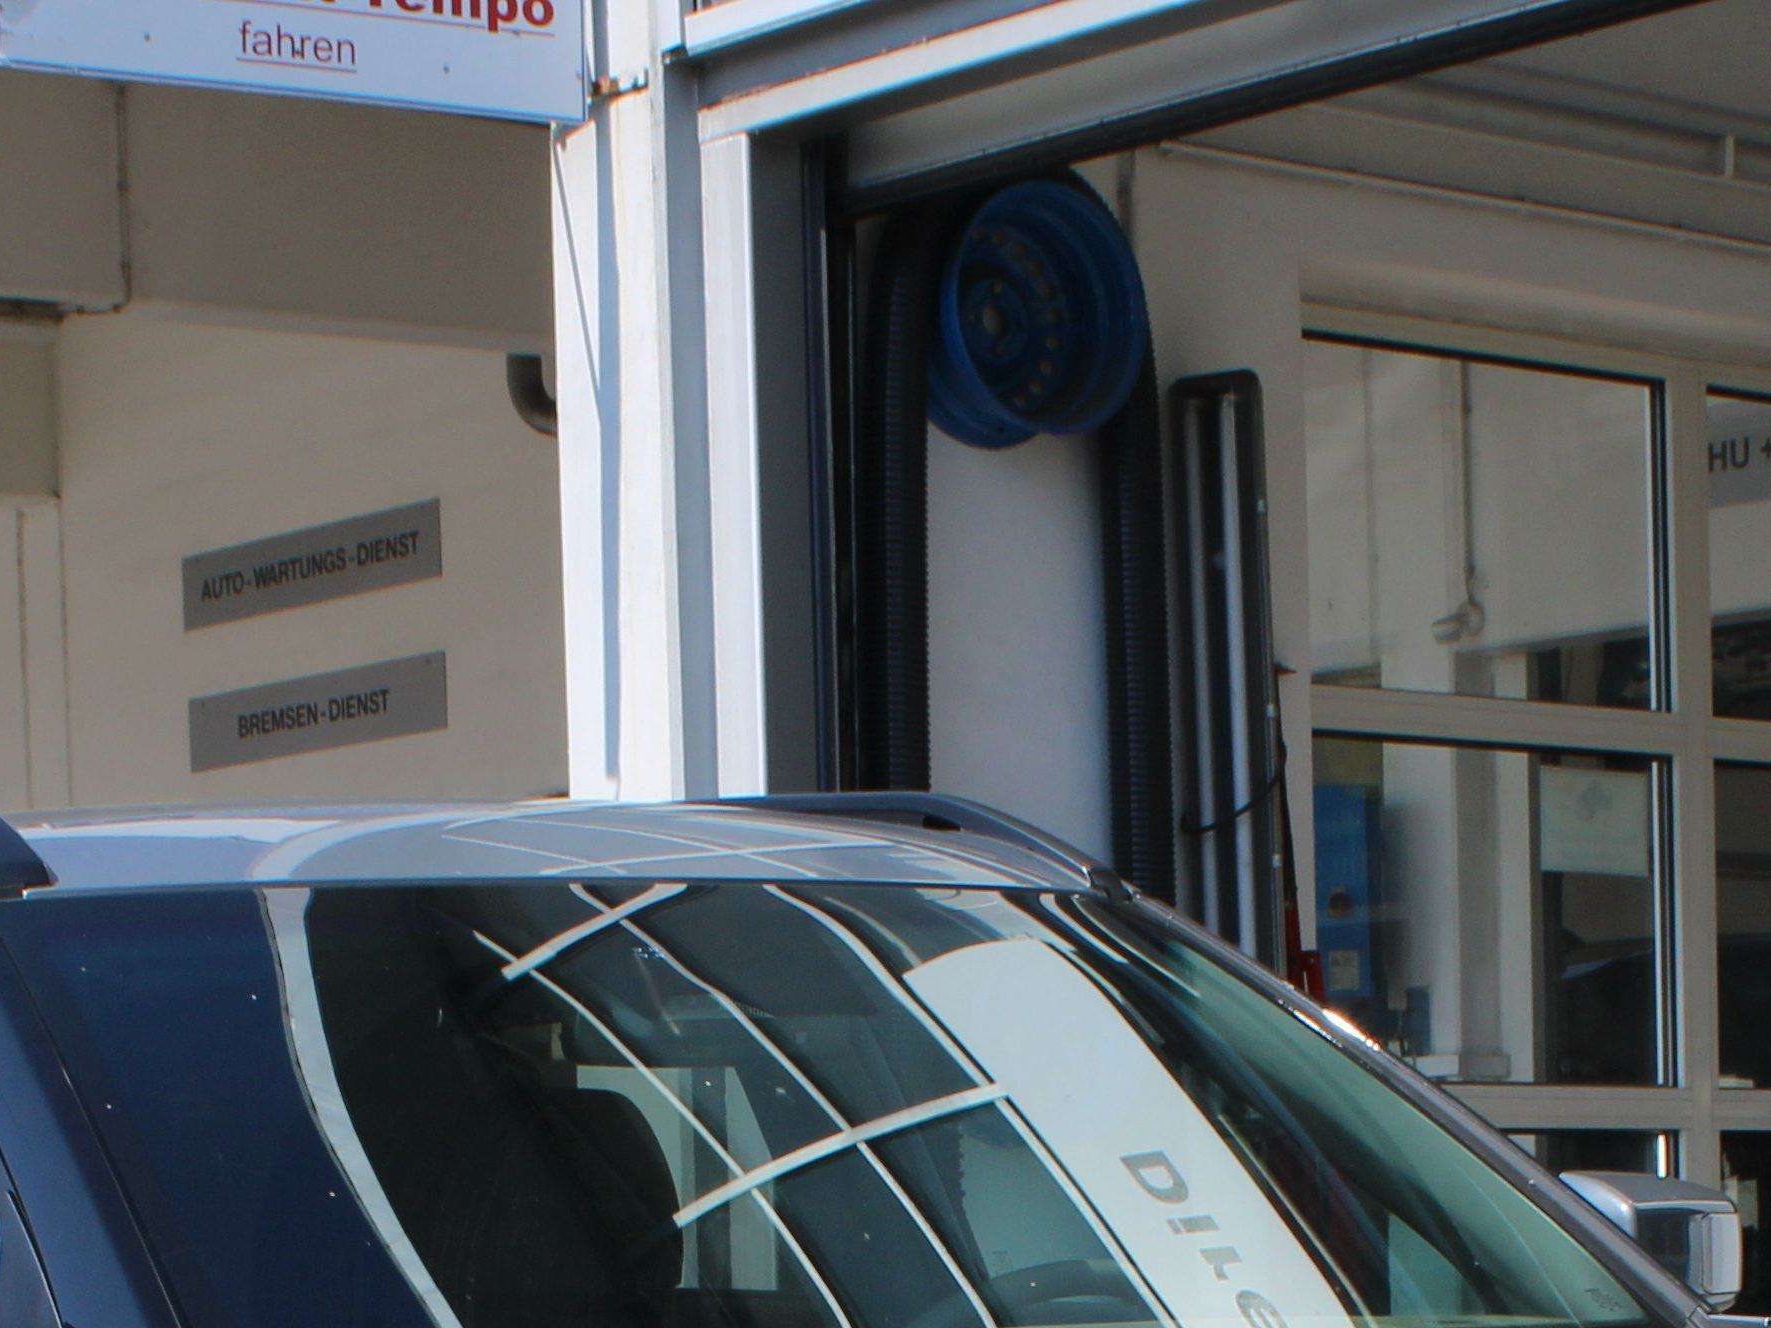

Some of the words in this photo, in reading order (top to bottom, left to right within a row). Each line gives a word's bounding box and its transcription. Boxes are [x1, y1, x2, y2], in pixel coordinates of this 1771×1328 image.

[240, 20, 357, 66] fahren
[1708, 437, 1751, 473] HU
[200, 530, 420, 602] AUTO-WARTUNGS-DIENST
[237, 688, 391, 740] BREMSEN-DIENST
